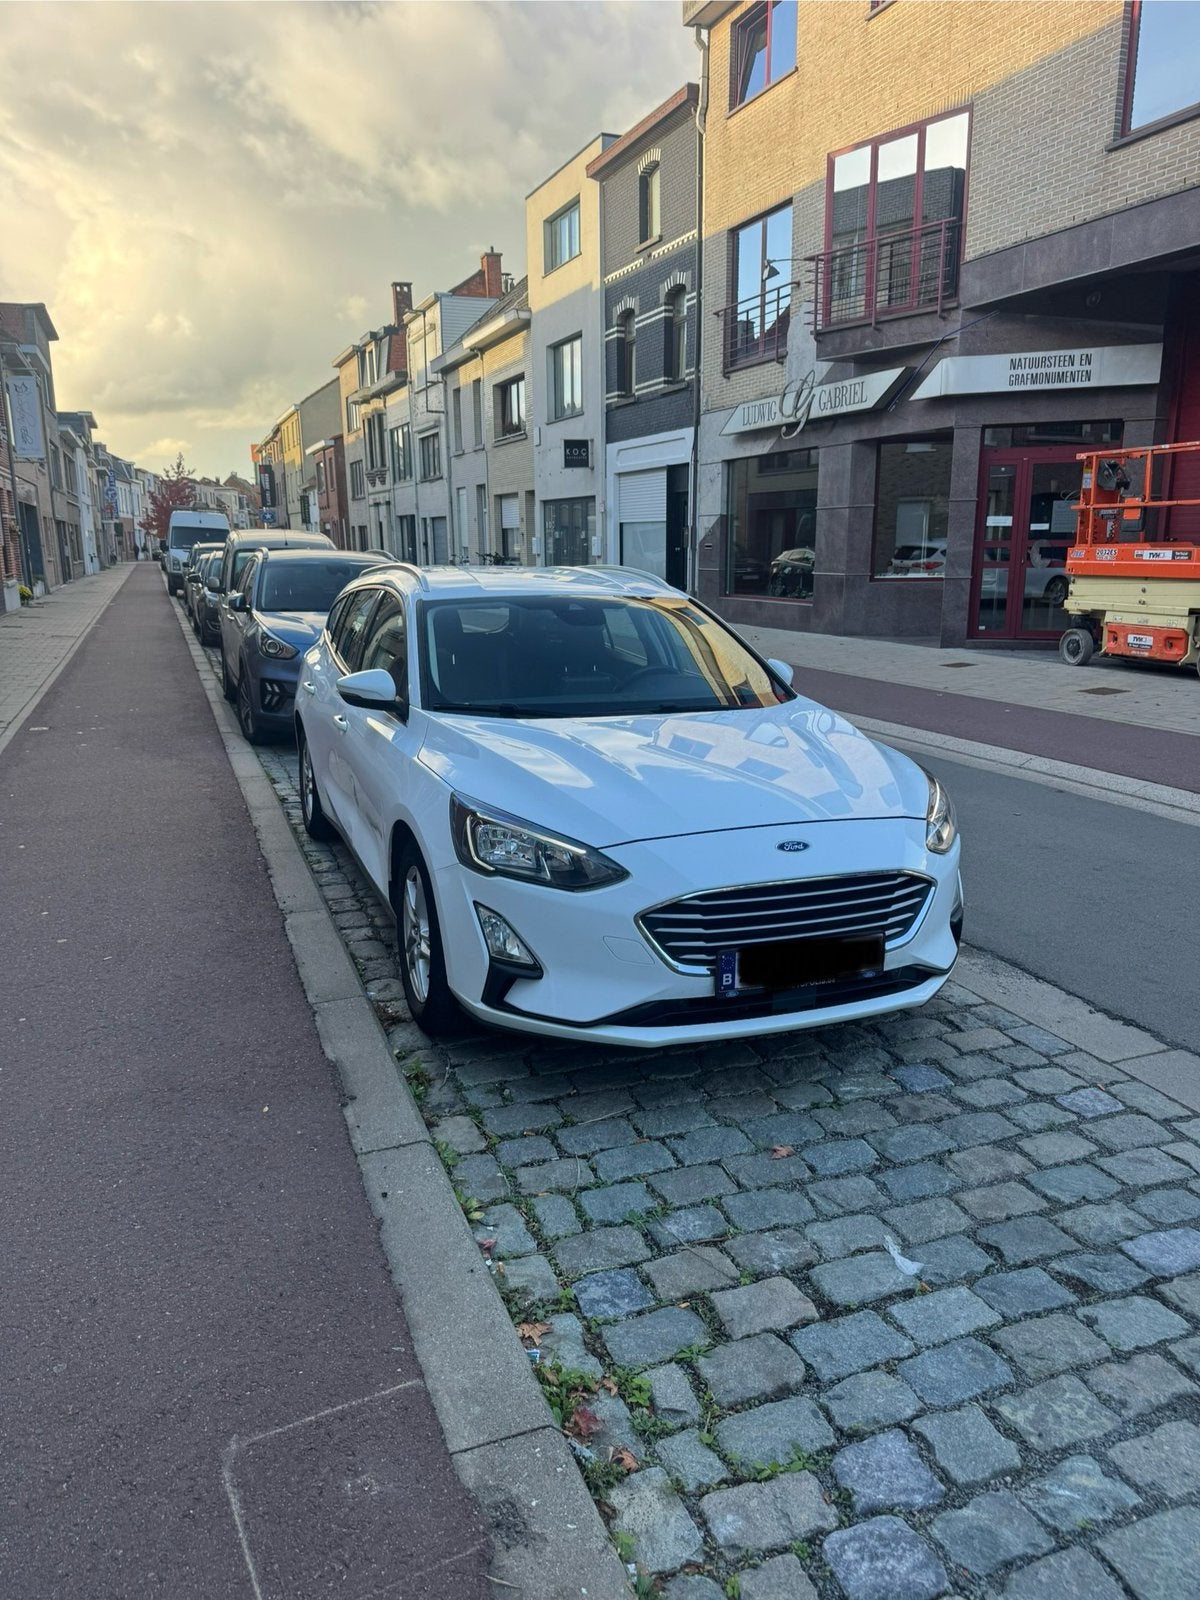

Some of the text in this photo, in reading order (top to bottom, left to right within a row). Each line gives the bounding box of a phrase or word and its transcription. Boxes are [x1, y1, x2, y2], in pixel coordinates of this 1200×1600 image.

[1009, 353, 1092, 371] NATUURSTEEN EN
[1008, 369, 1092, 387] GRAFMONUMENTEN
[742, 400, 777, 426] LUDWIG
[818, 381, 868, 412] GABRIEL
[722, 973, 733, 986] B
